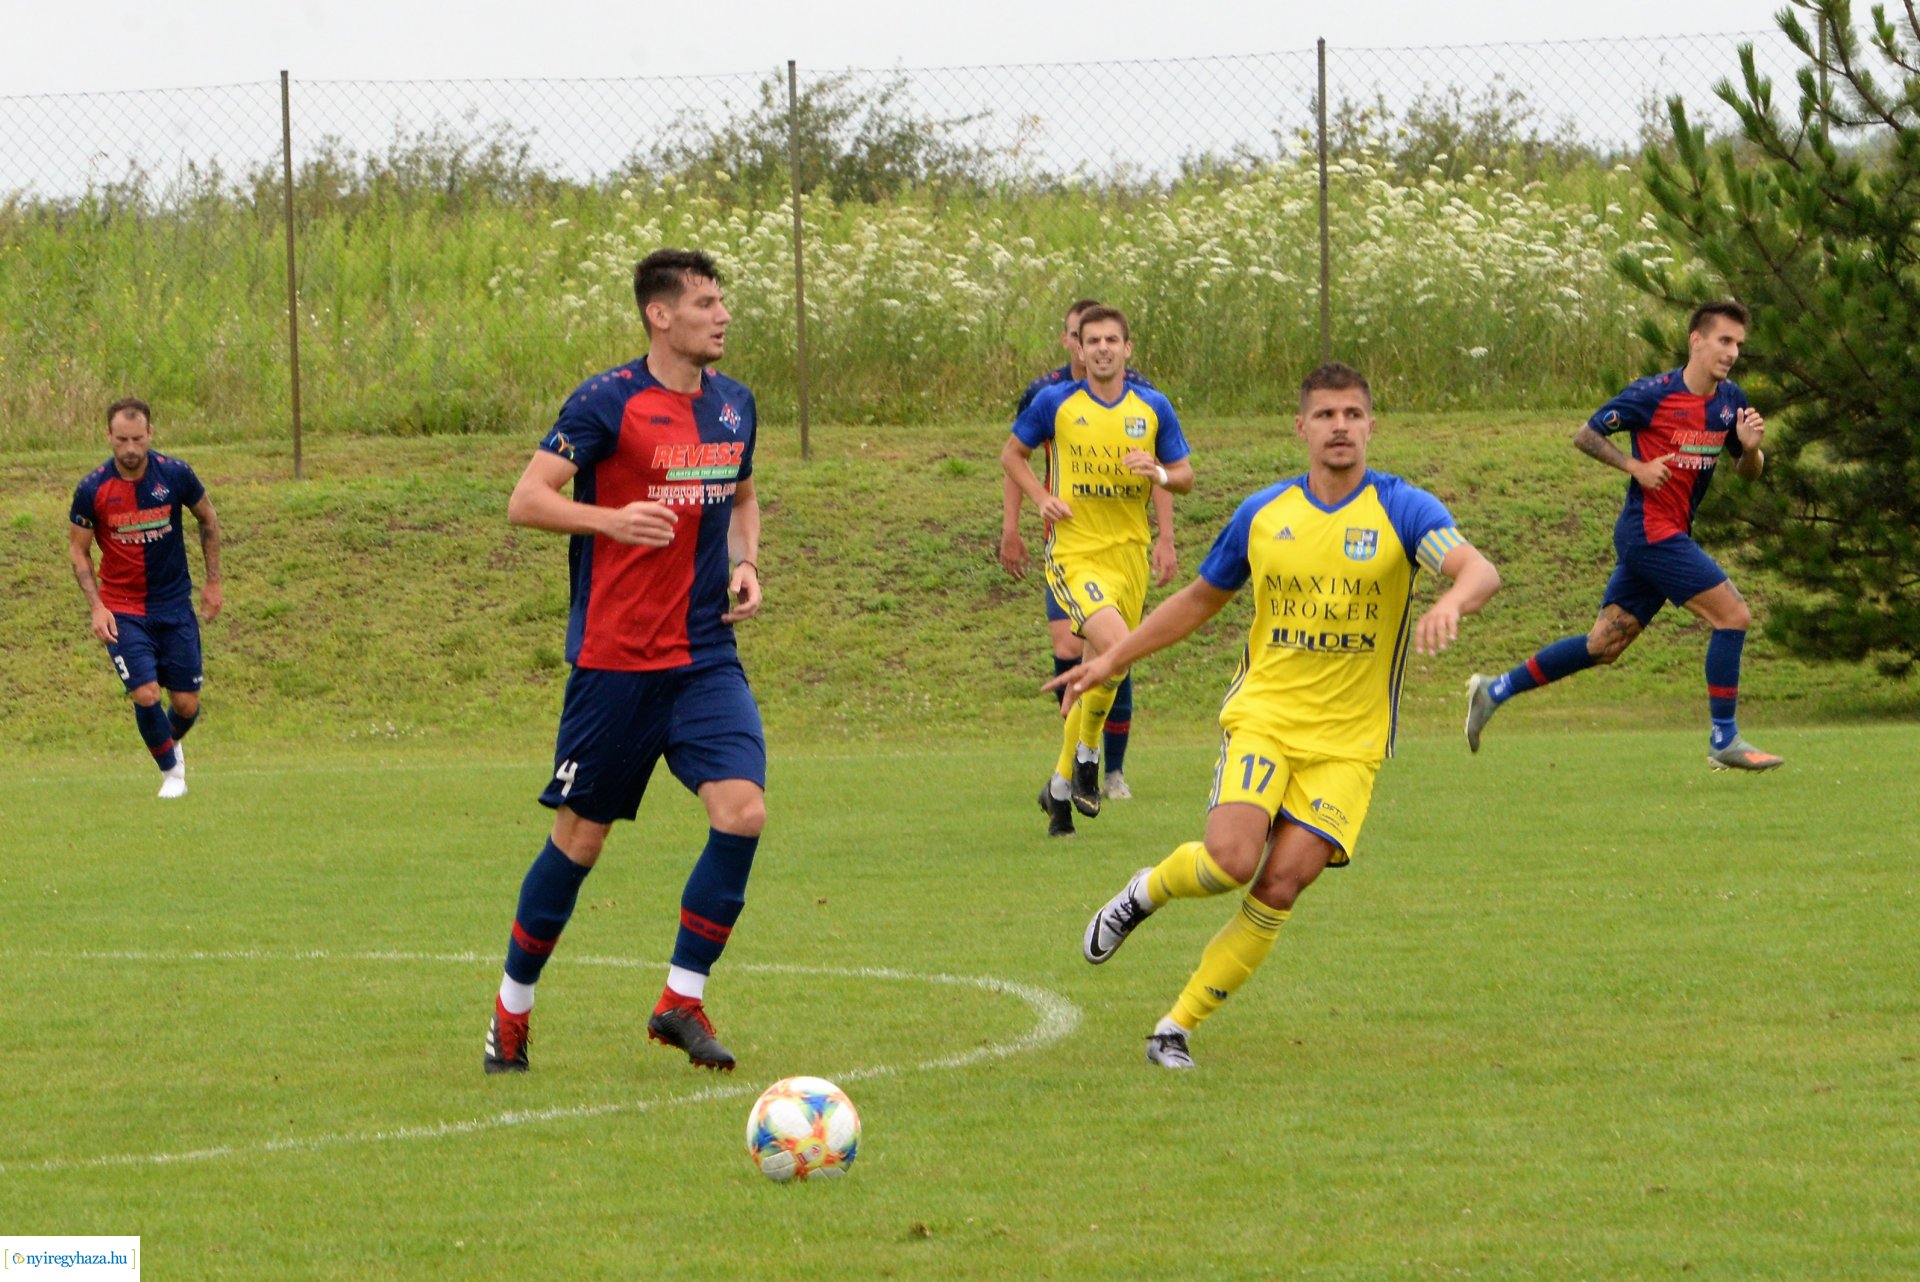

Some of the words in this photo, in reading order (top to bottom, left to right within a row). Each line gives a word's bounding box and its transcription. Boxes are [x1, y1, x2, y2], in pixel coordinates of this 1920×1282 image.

[651, 442, 745, 469] REVESZ
[1070, 444, 1146, 458] MAXI
[1084, 581, 1104, 602] 8
[1265, 574, 1382, 596] MAXIMA
[1270, 598, 1379, 620] BROKER
[556, 758, 578, 798] 4
[1240, 753, 1276, 794] 17
